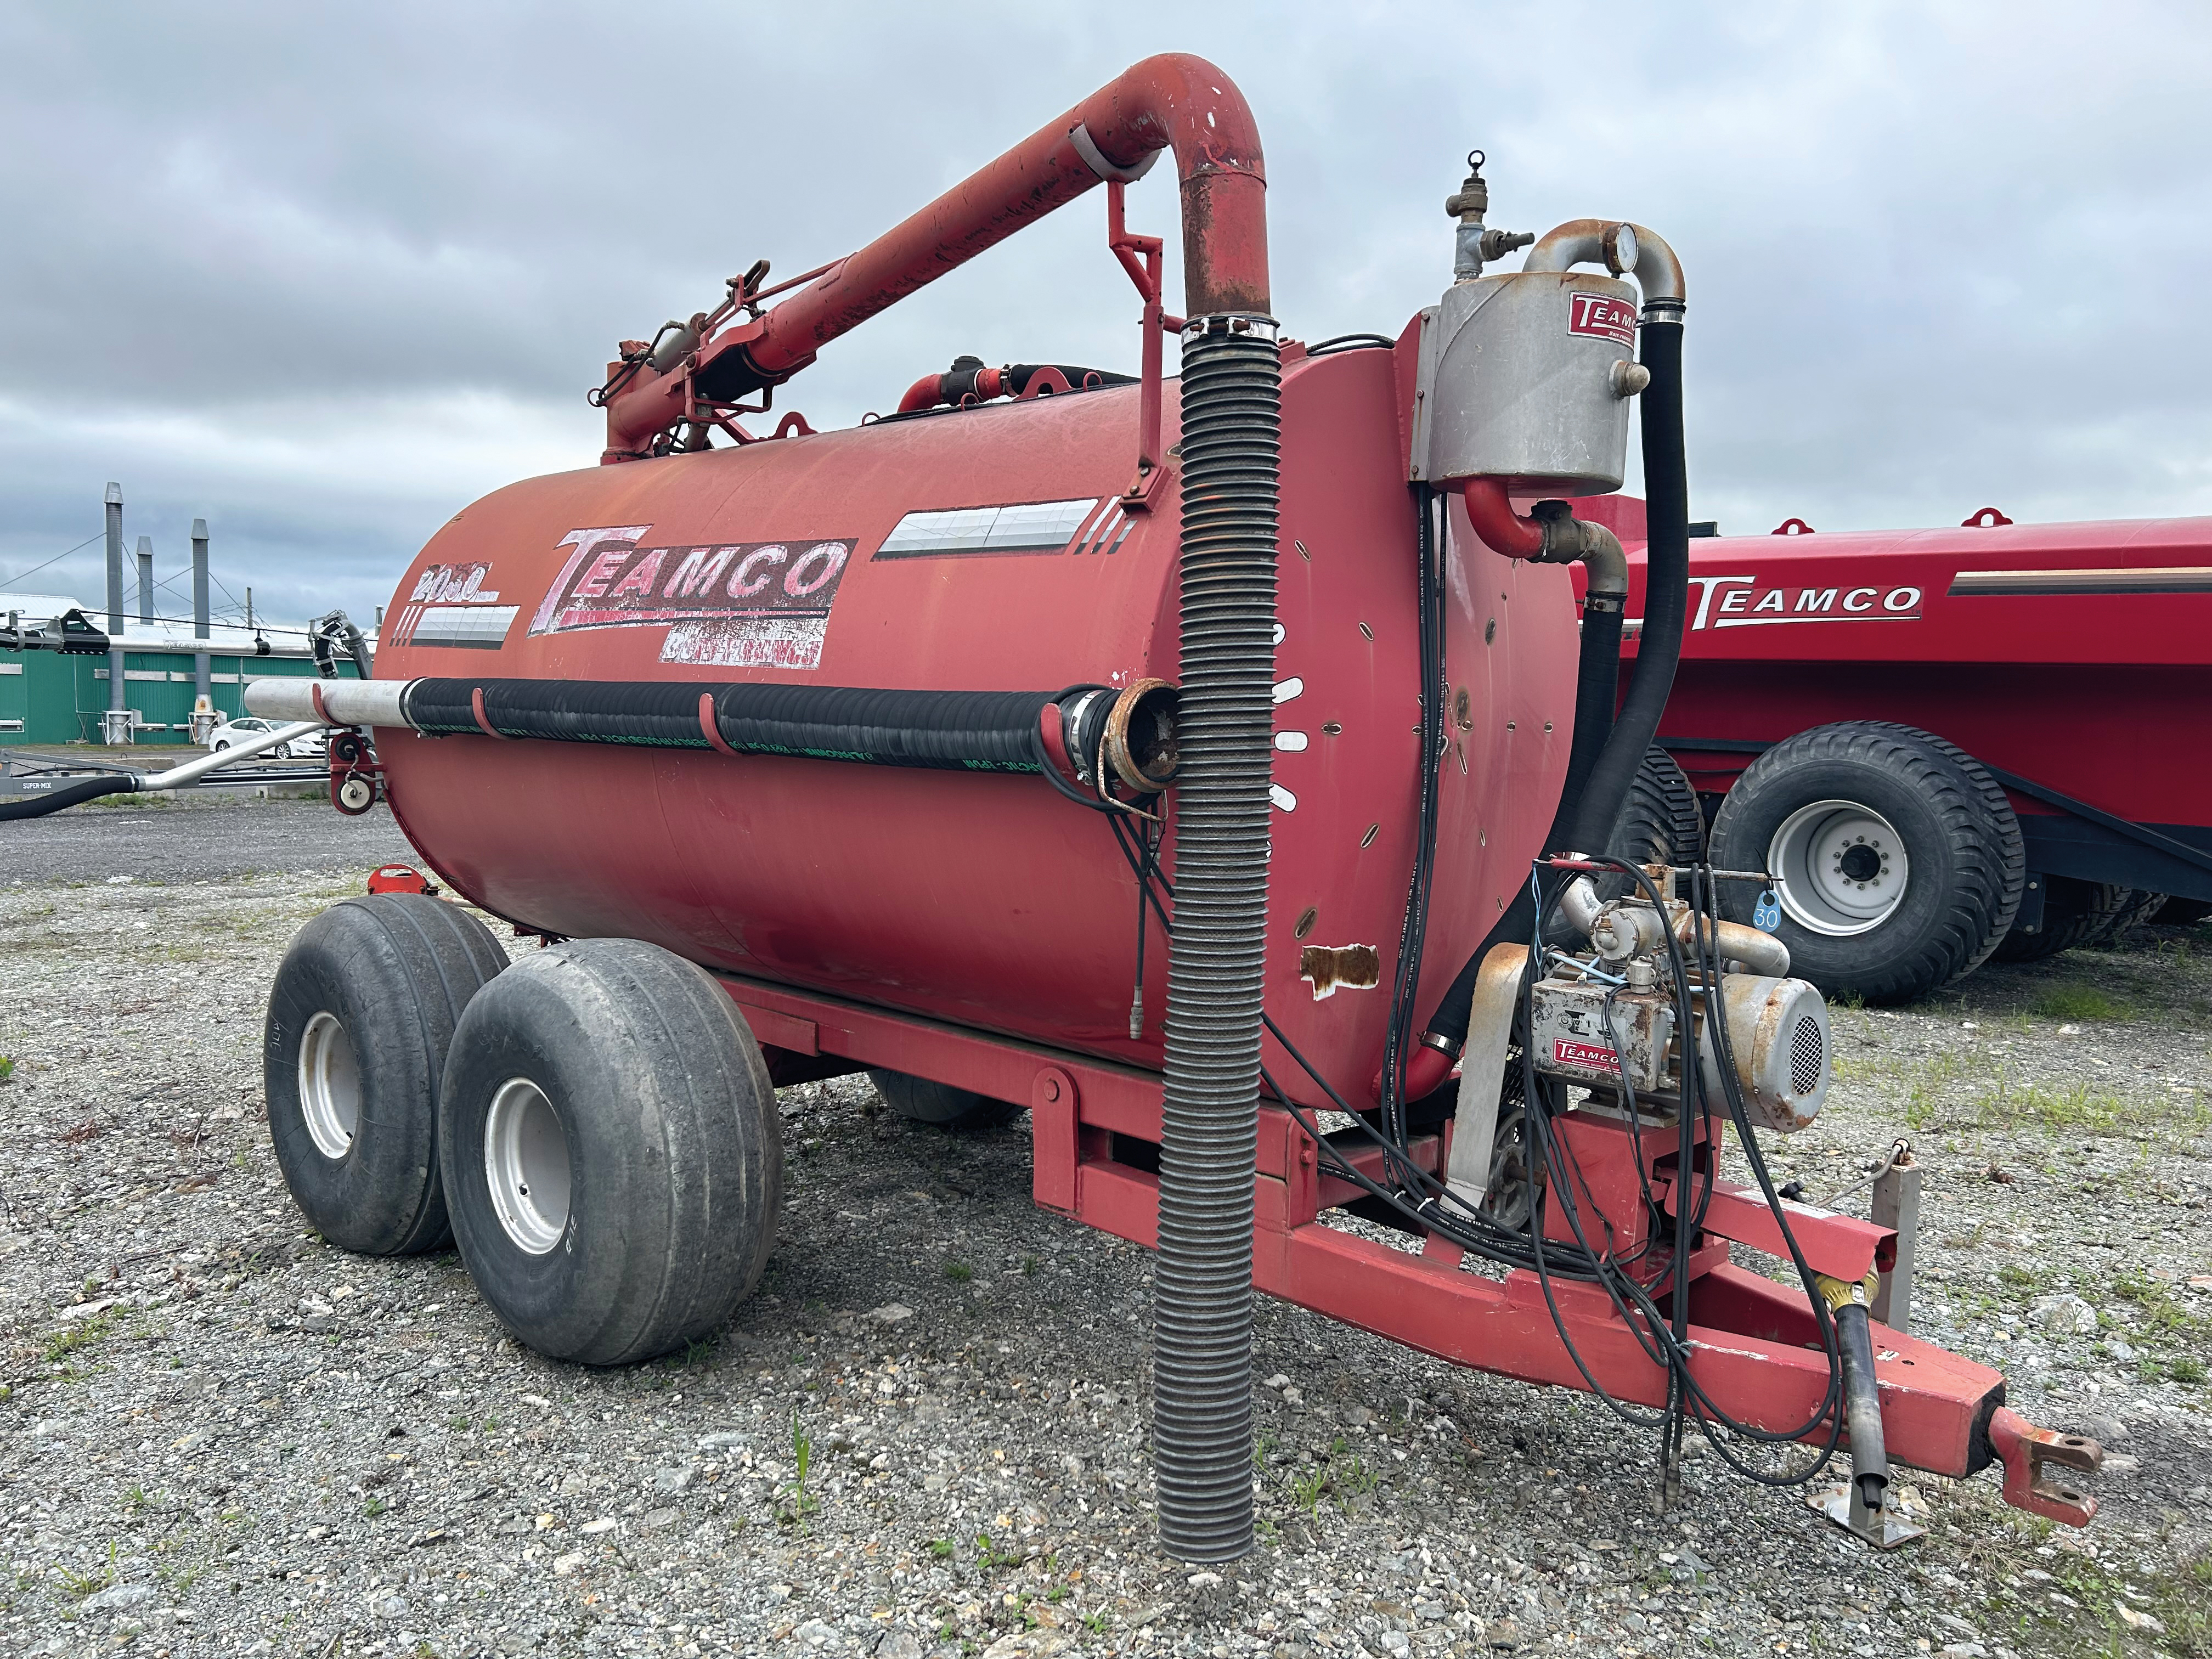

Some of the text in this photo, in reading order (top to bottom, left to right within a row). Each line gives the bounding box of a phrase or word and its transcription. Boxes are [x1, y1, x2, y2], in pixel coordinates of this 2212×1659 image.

[528, 524, 849, 636] TEAMCO
[1688, 575, 1921, 630] TEAMCO
[1755, 909, 1778, 928] 30
[1558, 1042, 1619, 1063] TEAMCO
